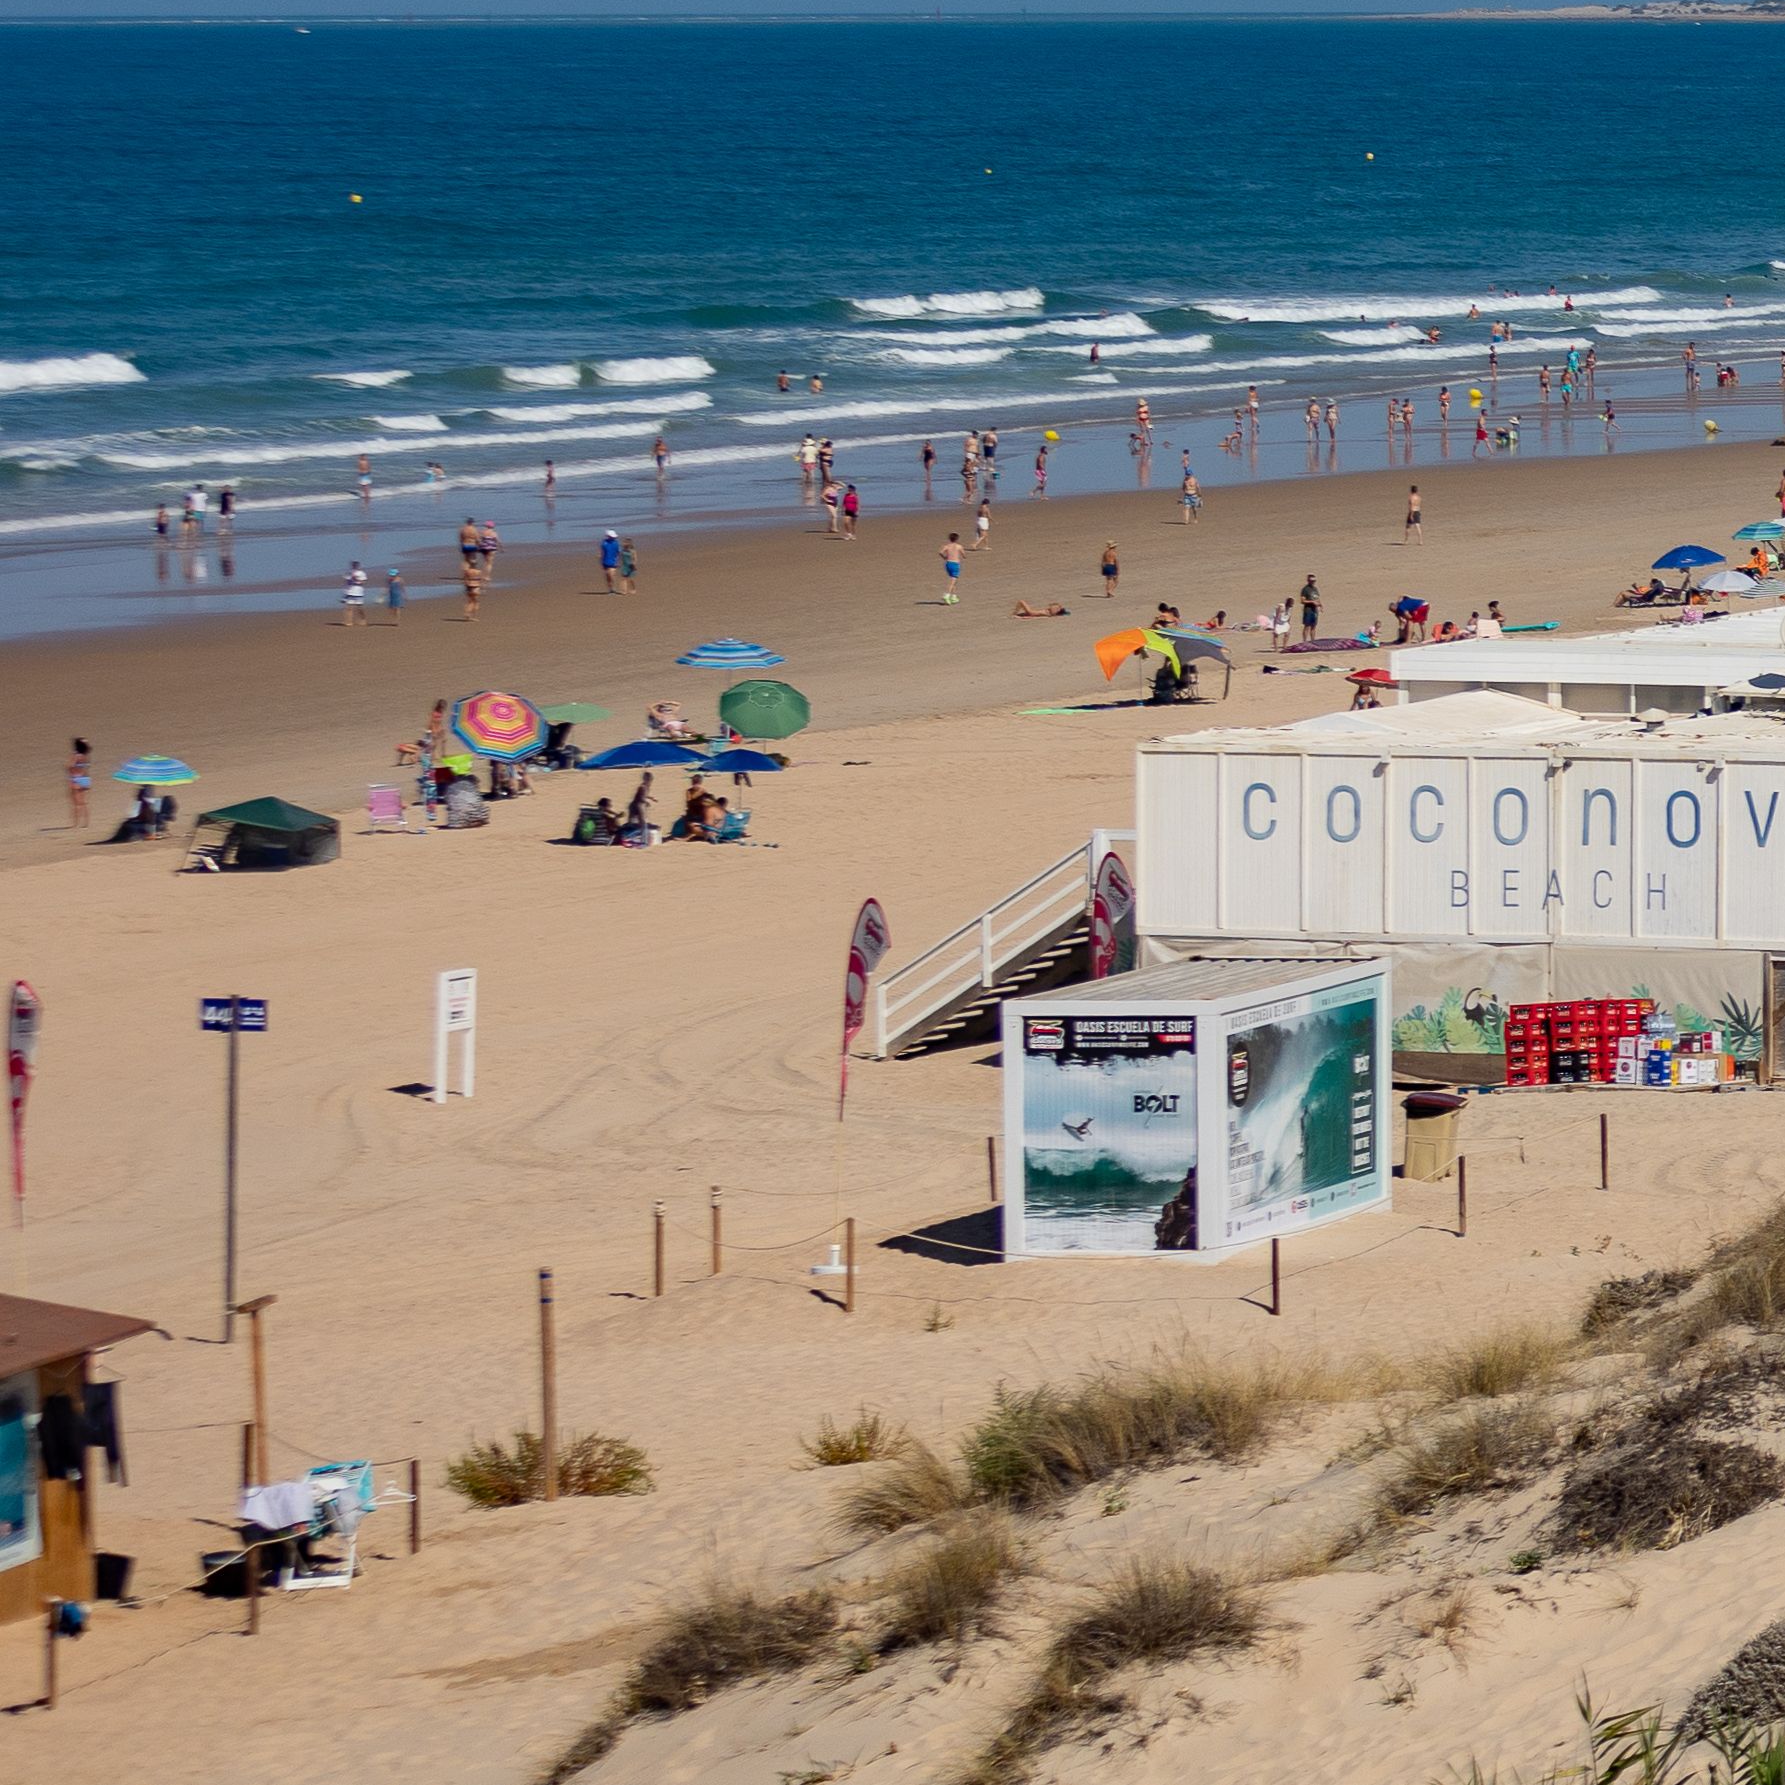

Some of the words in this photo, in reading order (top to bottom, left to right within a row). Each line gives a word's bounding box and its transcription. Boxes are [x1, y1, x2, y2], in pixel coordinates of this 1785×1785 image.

[1450, 868, 1668, 911] BEACH
[1074, 1021, 1105, 1032] OASIS
[1106, 1021, 1150, 1032] ESCUELA
[1151, 1021, 1165, 1032] DE
[1166, 1020, 1193, 1032] SURF
[1133, 1094, 1180, 1113] BOLT
